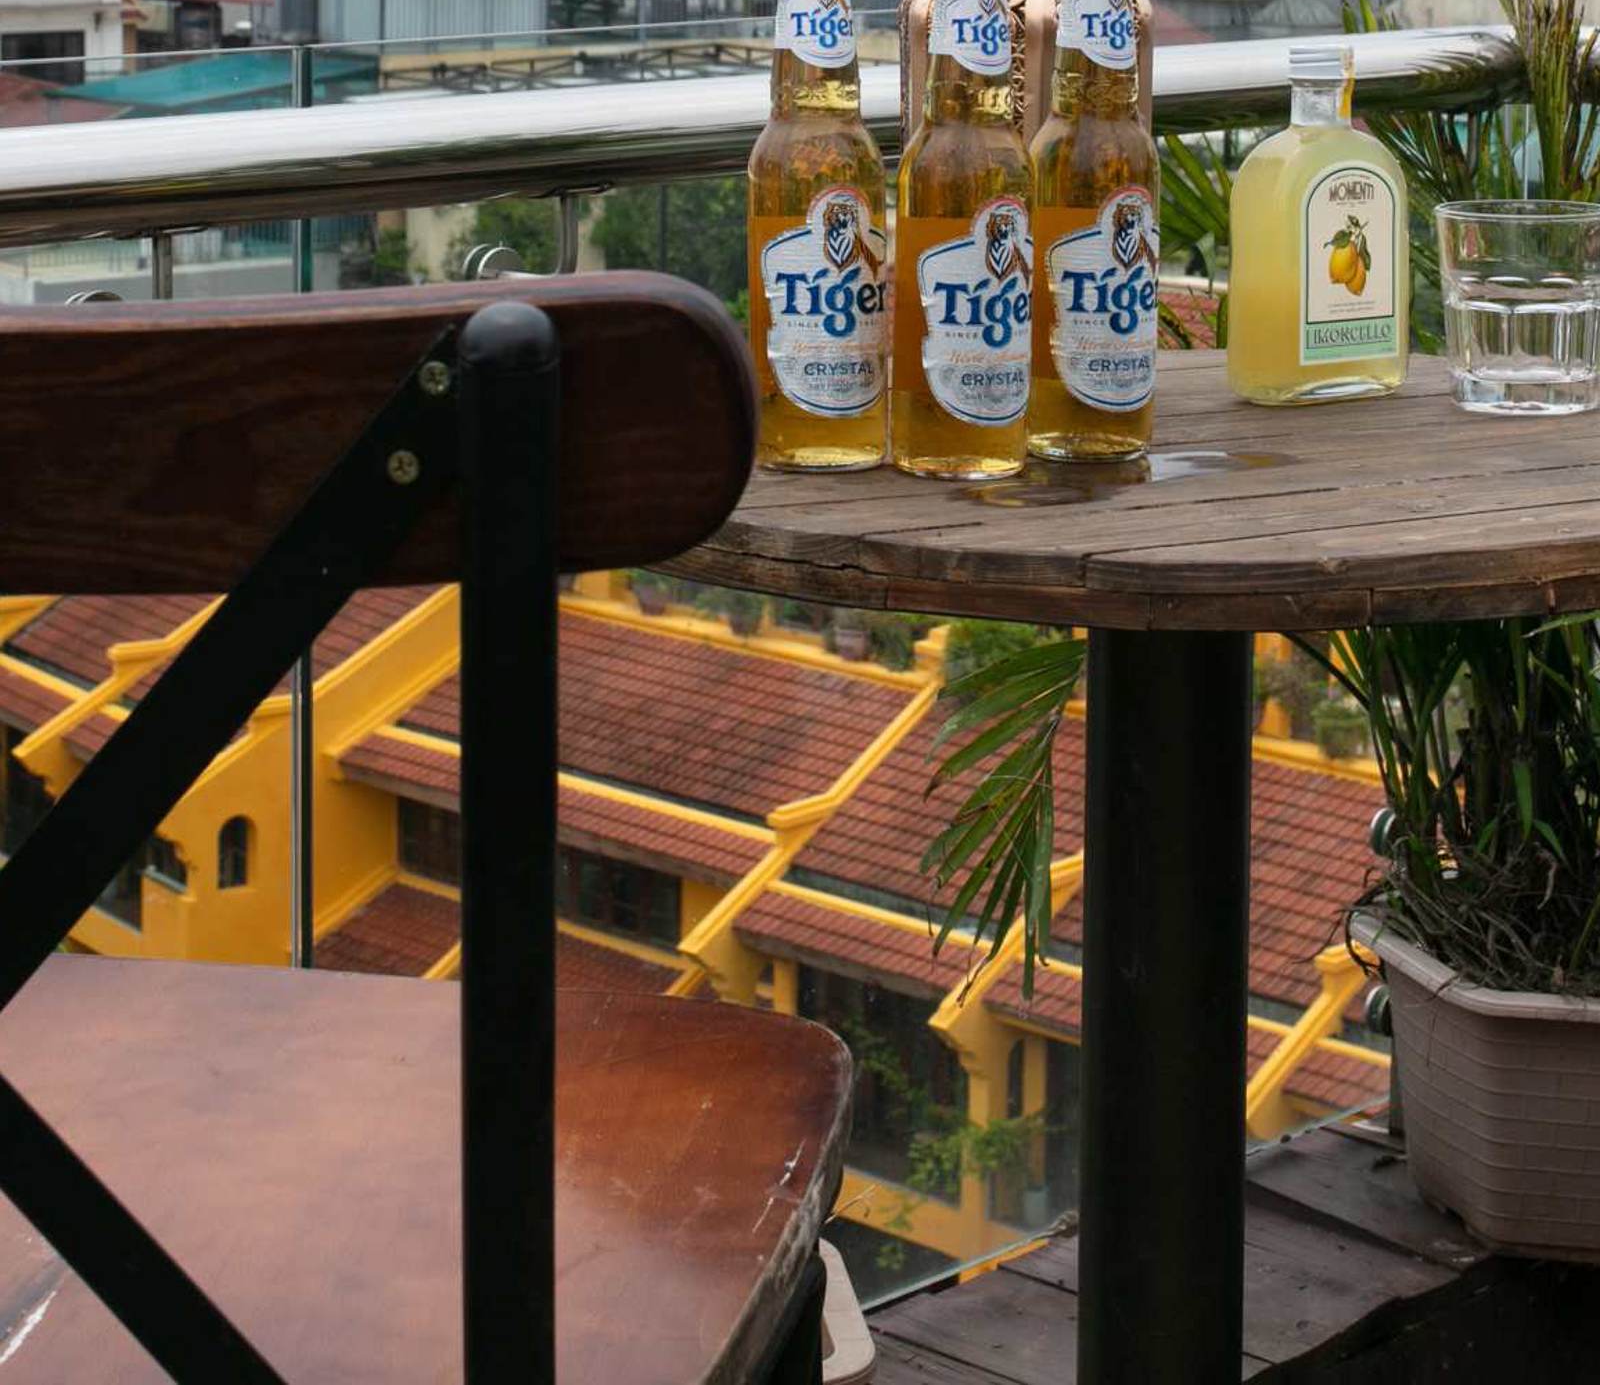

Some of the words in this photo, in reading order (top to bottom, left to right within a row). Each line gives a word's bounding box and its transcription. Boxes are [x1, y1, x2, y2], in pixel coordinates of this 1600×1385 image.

[951, 14, 1009, 56] Tige
[1081, 9, 1134, 50] Tige
[933, 277, 1033, 348] Tige
[803, 360, 874, 376] CRYSTAL
